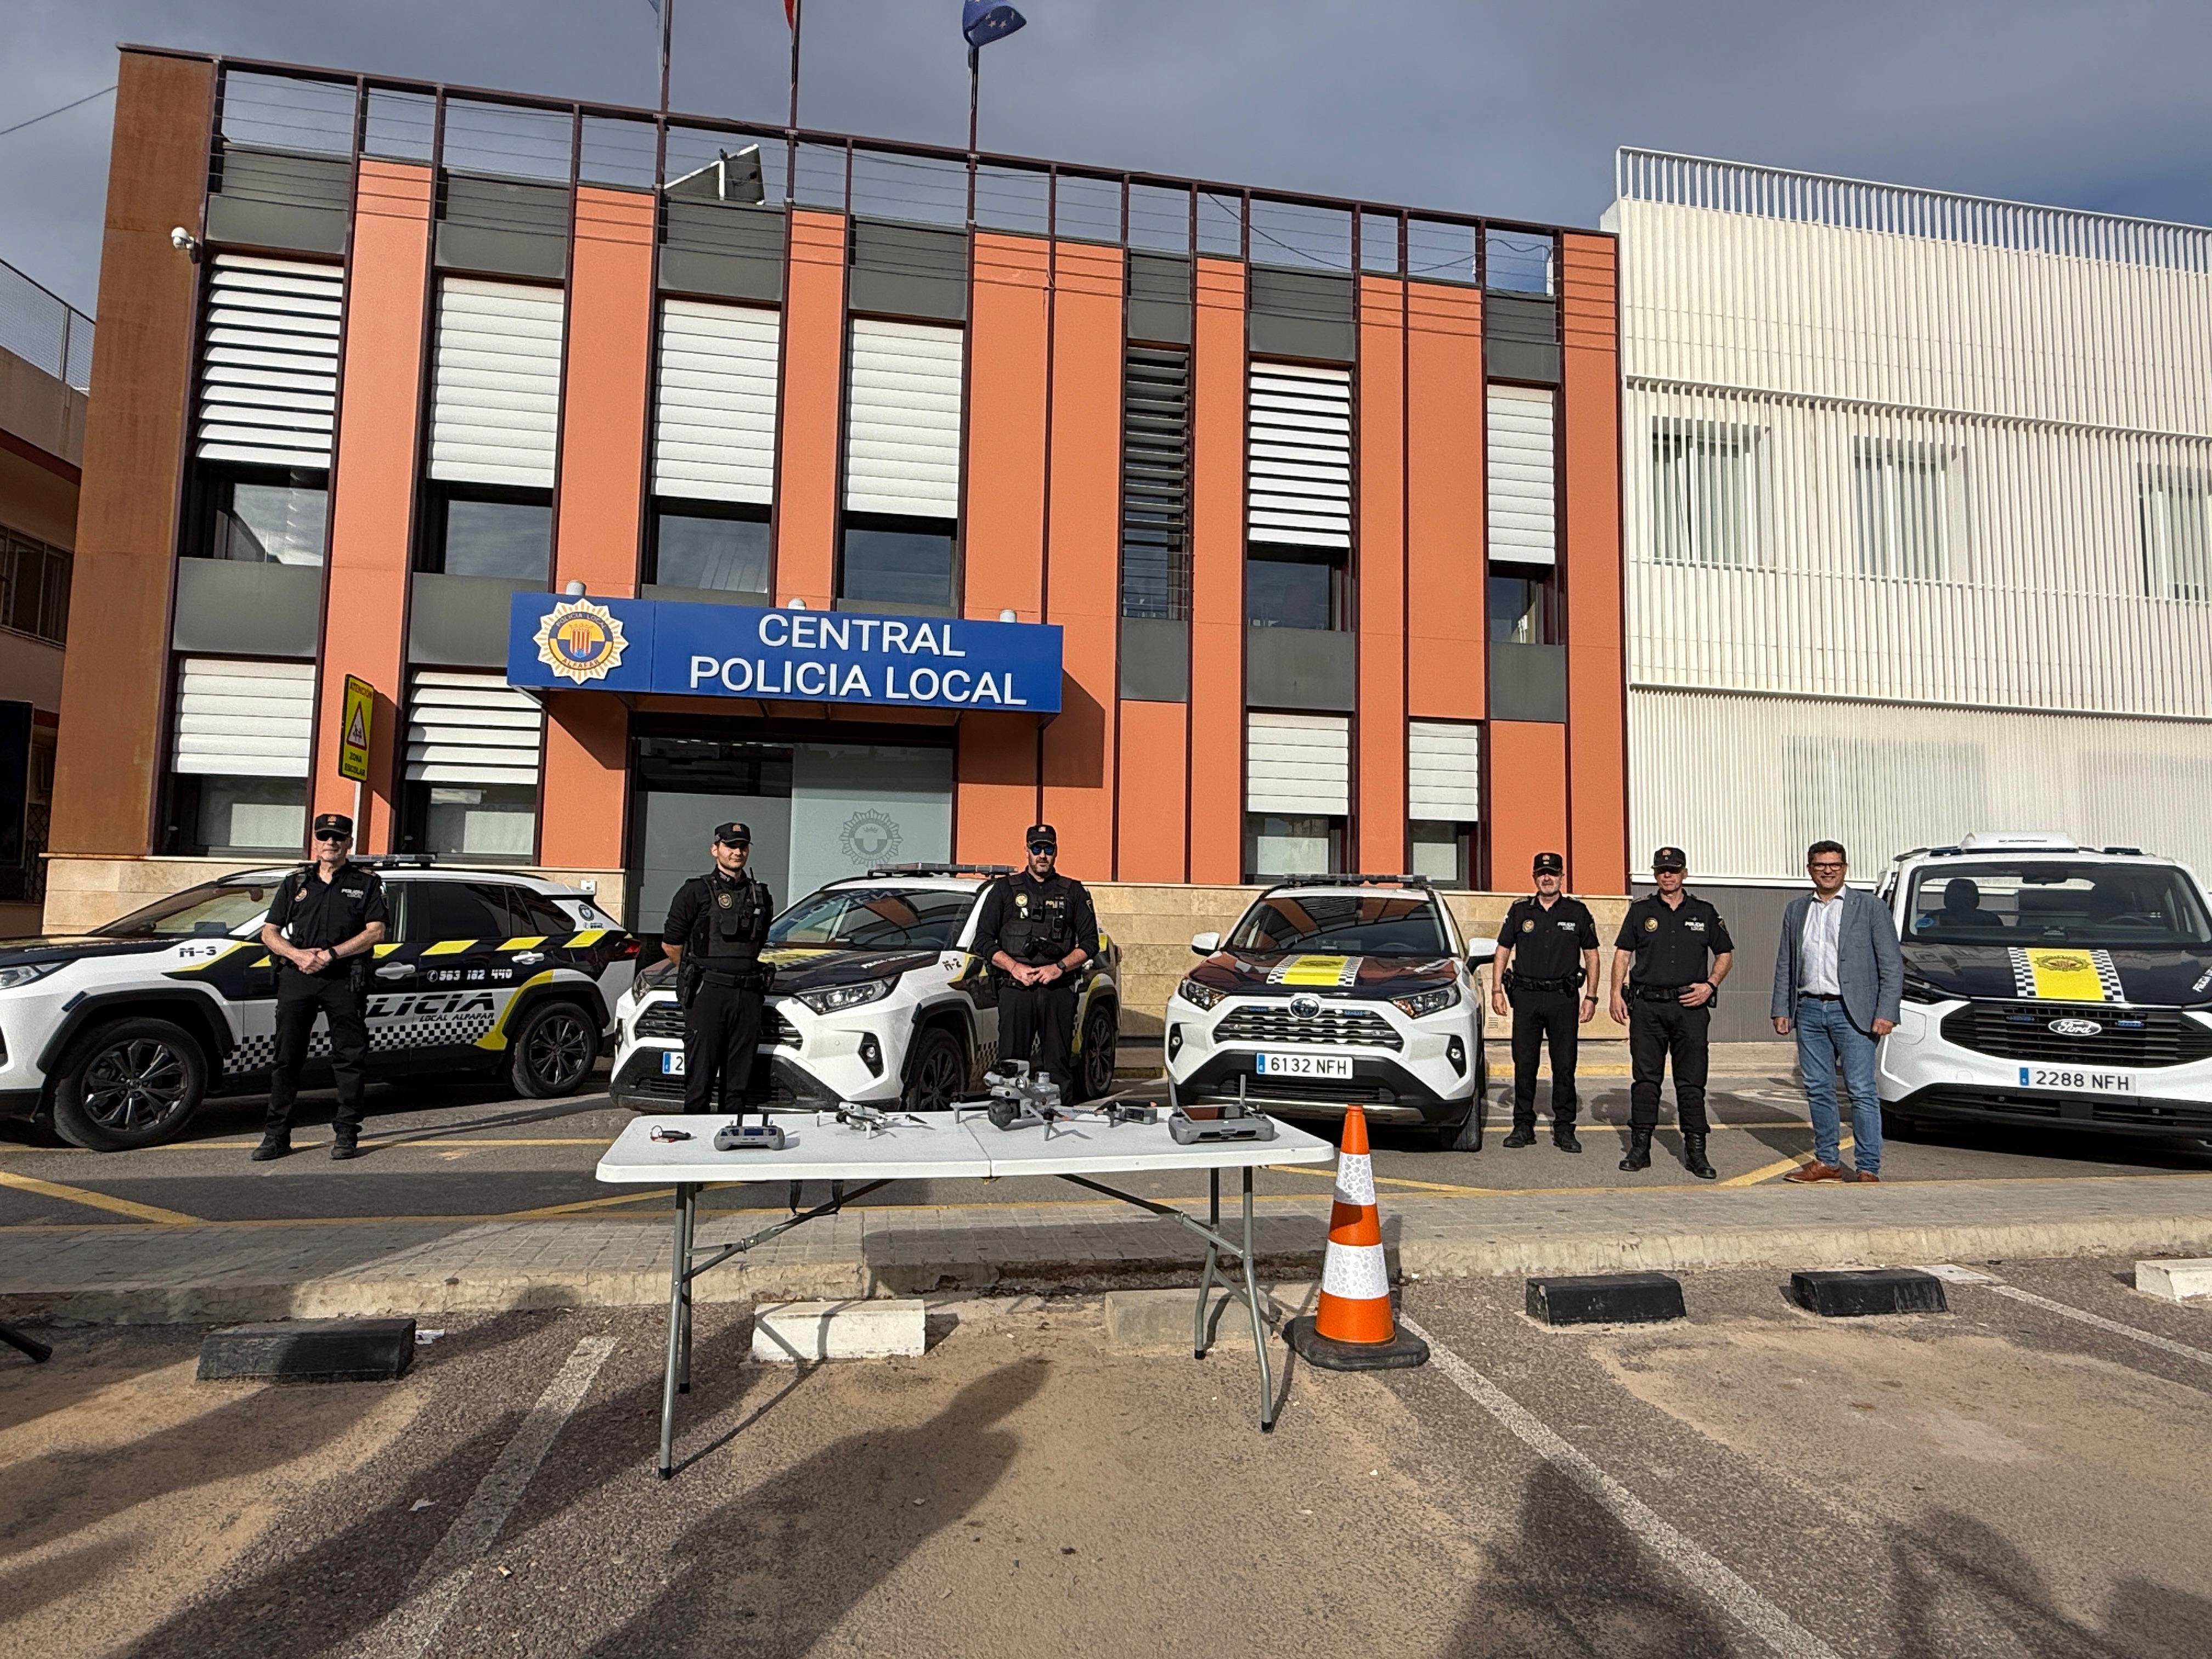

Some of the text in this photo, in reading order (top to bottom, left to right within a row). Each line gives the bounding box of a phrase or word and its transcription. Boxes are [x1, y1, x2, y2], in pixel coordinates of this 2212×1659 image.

[556, 613, 583, 627] POLICIA
[758, 613, 966, 658] CENTRAL
[561, 658, 600, 669] ALFAFAR
[690, 656, 1028, 706] POLICIA LOCAL
[366, 992, 494, 1017] LICIA
[2057, 1020, 2092, 1034] Ford
[1271, 1057, 1346, 1075] 6132 NFH
[2036, 1070, 2129, 1091] 2288 NFH
